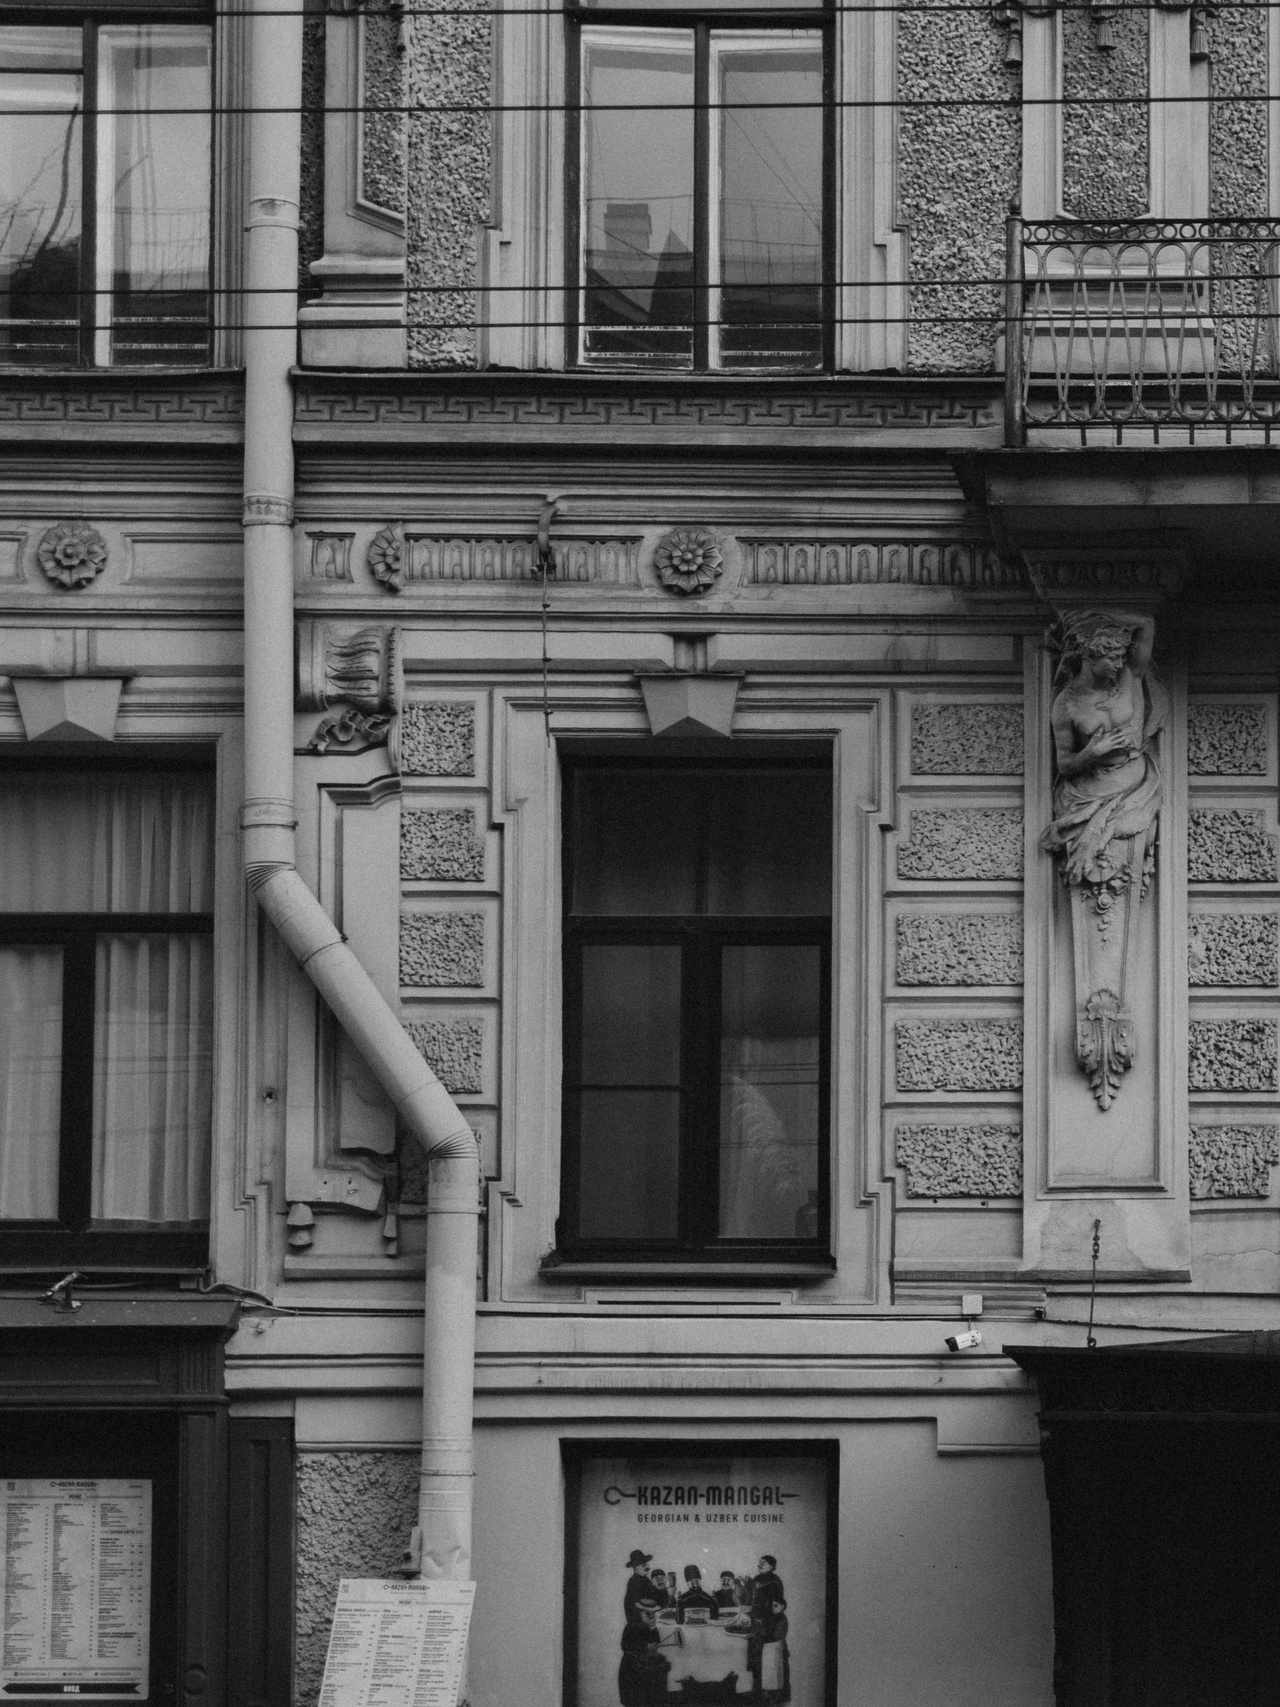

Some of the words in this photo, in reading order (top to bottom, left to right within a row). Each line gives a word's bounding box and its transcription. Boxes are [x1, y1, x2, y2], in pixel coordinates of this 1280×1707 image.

[637, 1485, 785, 1506] KAZAN-MANGAL
[637, 1513, 690, 1523] GEORGIAN
[694, 1513, 701, 1523] &
[706, 1513, 738, 1523] UZBEK
[744, 1513, 785, 1523] CUISINE
